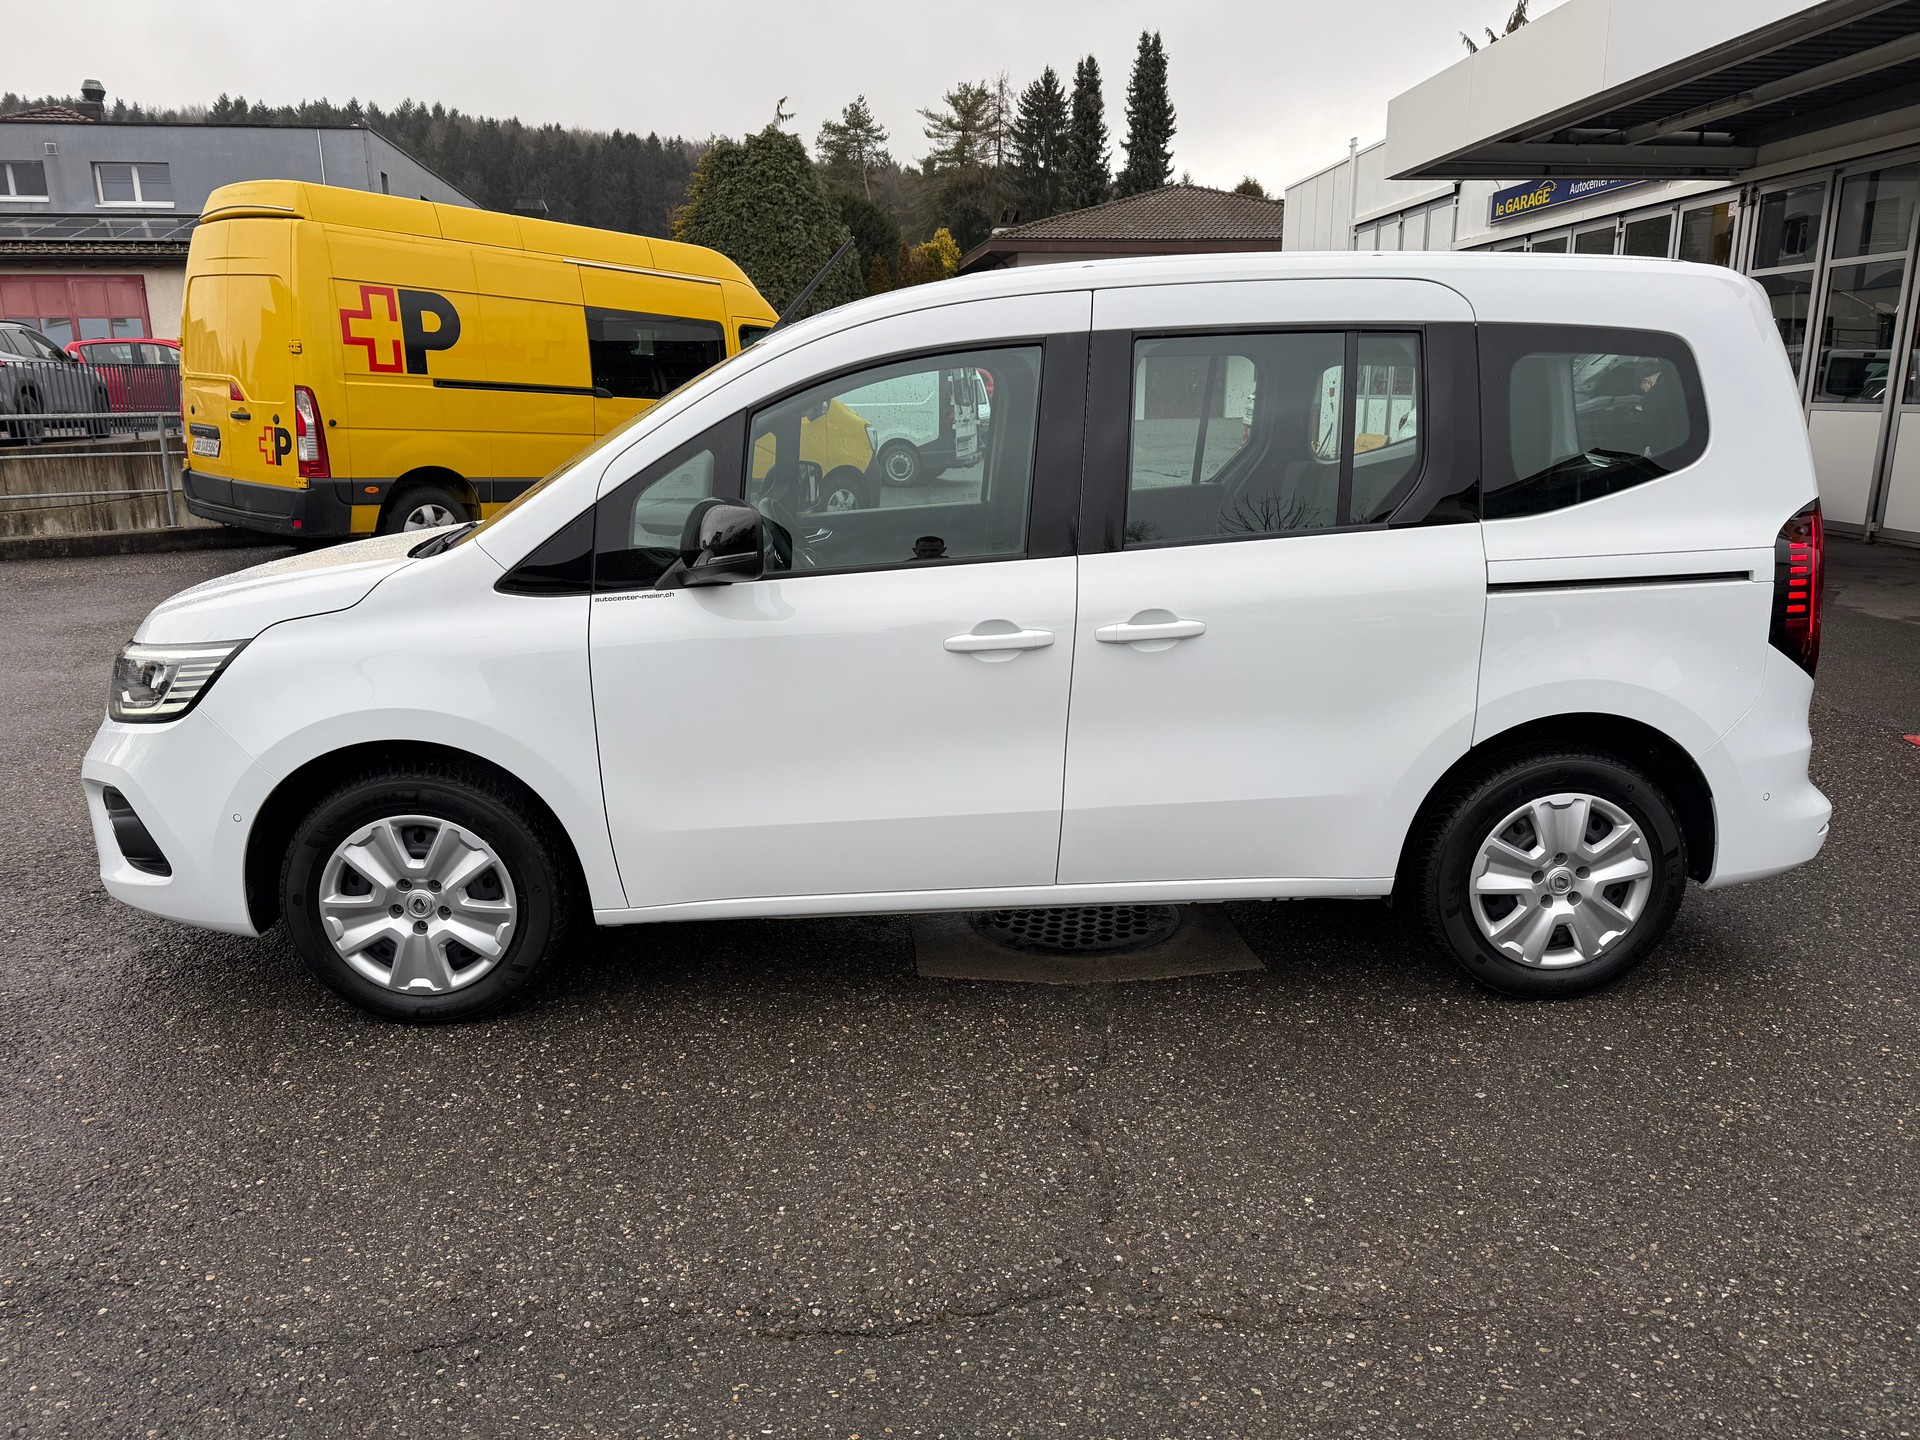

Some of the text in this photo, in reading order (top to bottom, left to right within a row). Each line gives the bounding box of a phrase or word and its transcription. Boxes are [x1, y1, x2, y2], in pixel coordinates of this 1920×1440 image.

[1495, 188, 1551, 217] le GARAGE
[397, 288, 461, 375] P
[273, 427, 292, 466] P
[594, 591, 675, 603] autocenter-meier.ch
